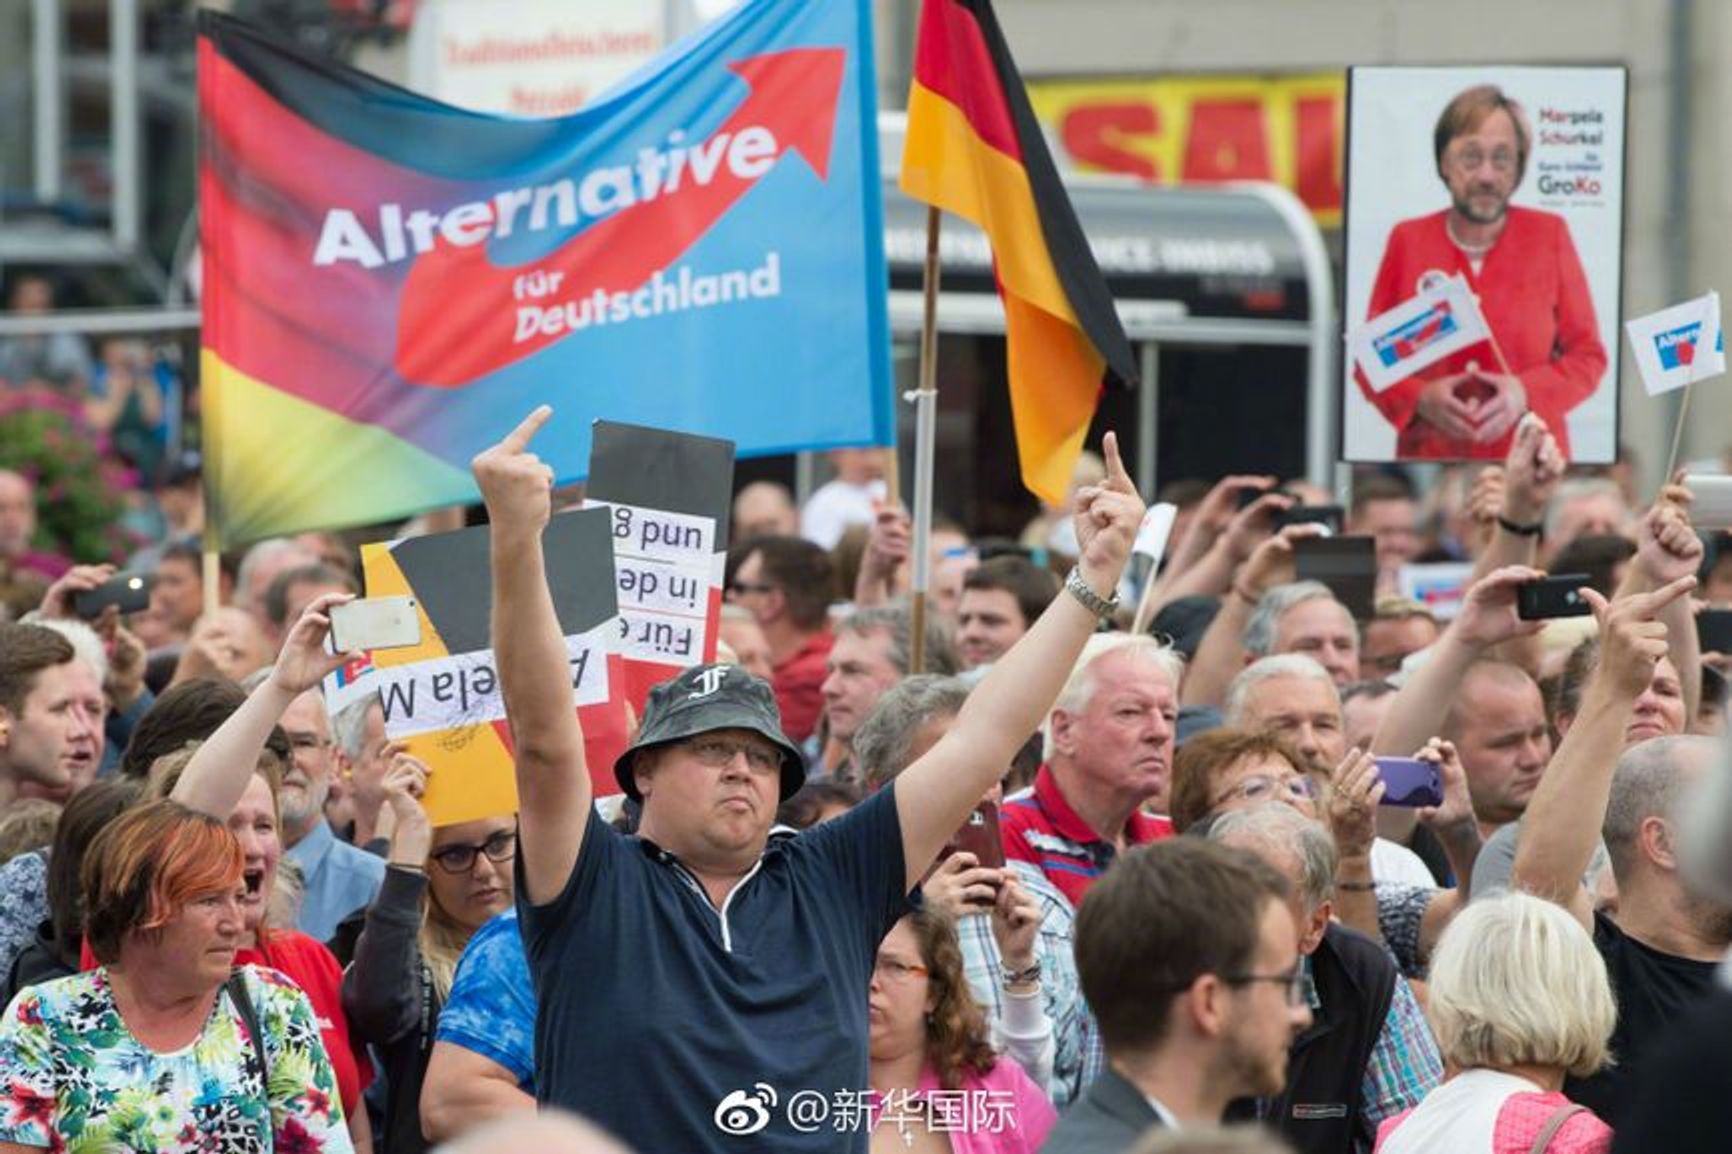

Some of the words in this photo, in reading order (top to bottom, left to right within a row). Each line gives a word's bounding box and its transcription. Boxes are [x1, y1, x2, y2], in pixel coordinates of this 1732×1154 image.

[312, 125, 777, 270] Alternative
[1538, 174, 1601, 195] GroKo
[513, 269, 564, 300] für
[513, 252, 781, 343] Deutschland
[640, 518, 702, 551] und
[668, 577, 697, 608] in
[638, 622, 692, 656] Für
